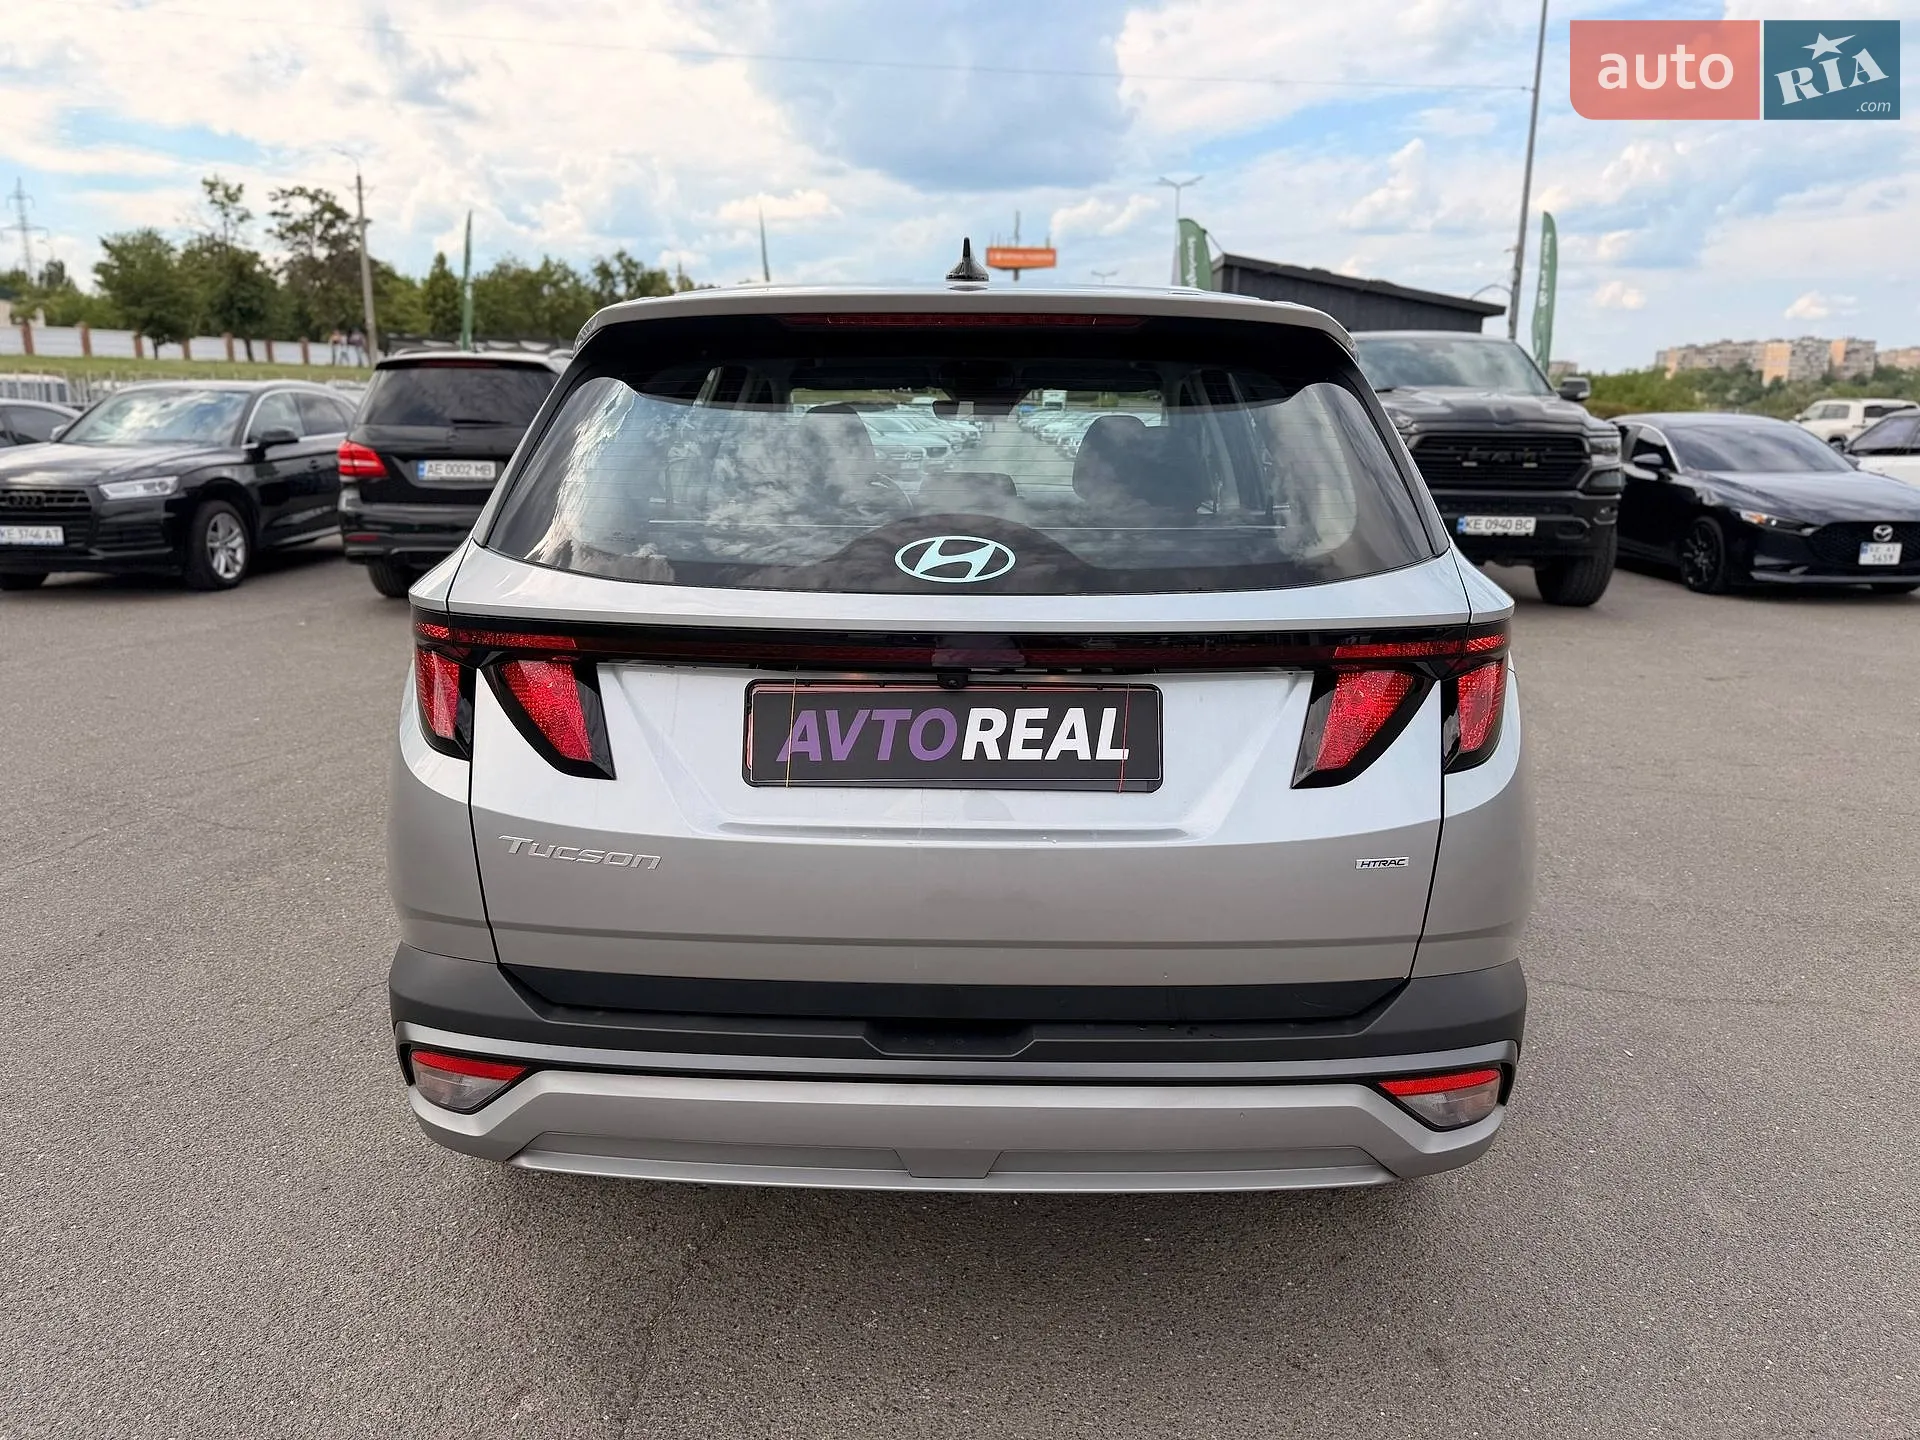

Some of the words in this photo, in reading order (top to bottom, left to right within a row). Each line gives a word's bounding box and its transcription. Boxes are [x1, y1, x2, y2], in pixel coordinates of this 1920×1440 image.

[428, 463, 442, 475] AE
[445, 463, 471, 475] 0002
[1485, 519, 1512, 530] 0940
[1515, 519, 1532, 530] BC
[776, 707, 1130, 761] AVTOREAL
[1360, 859, 1406, 868] HTRAC
